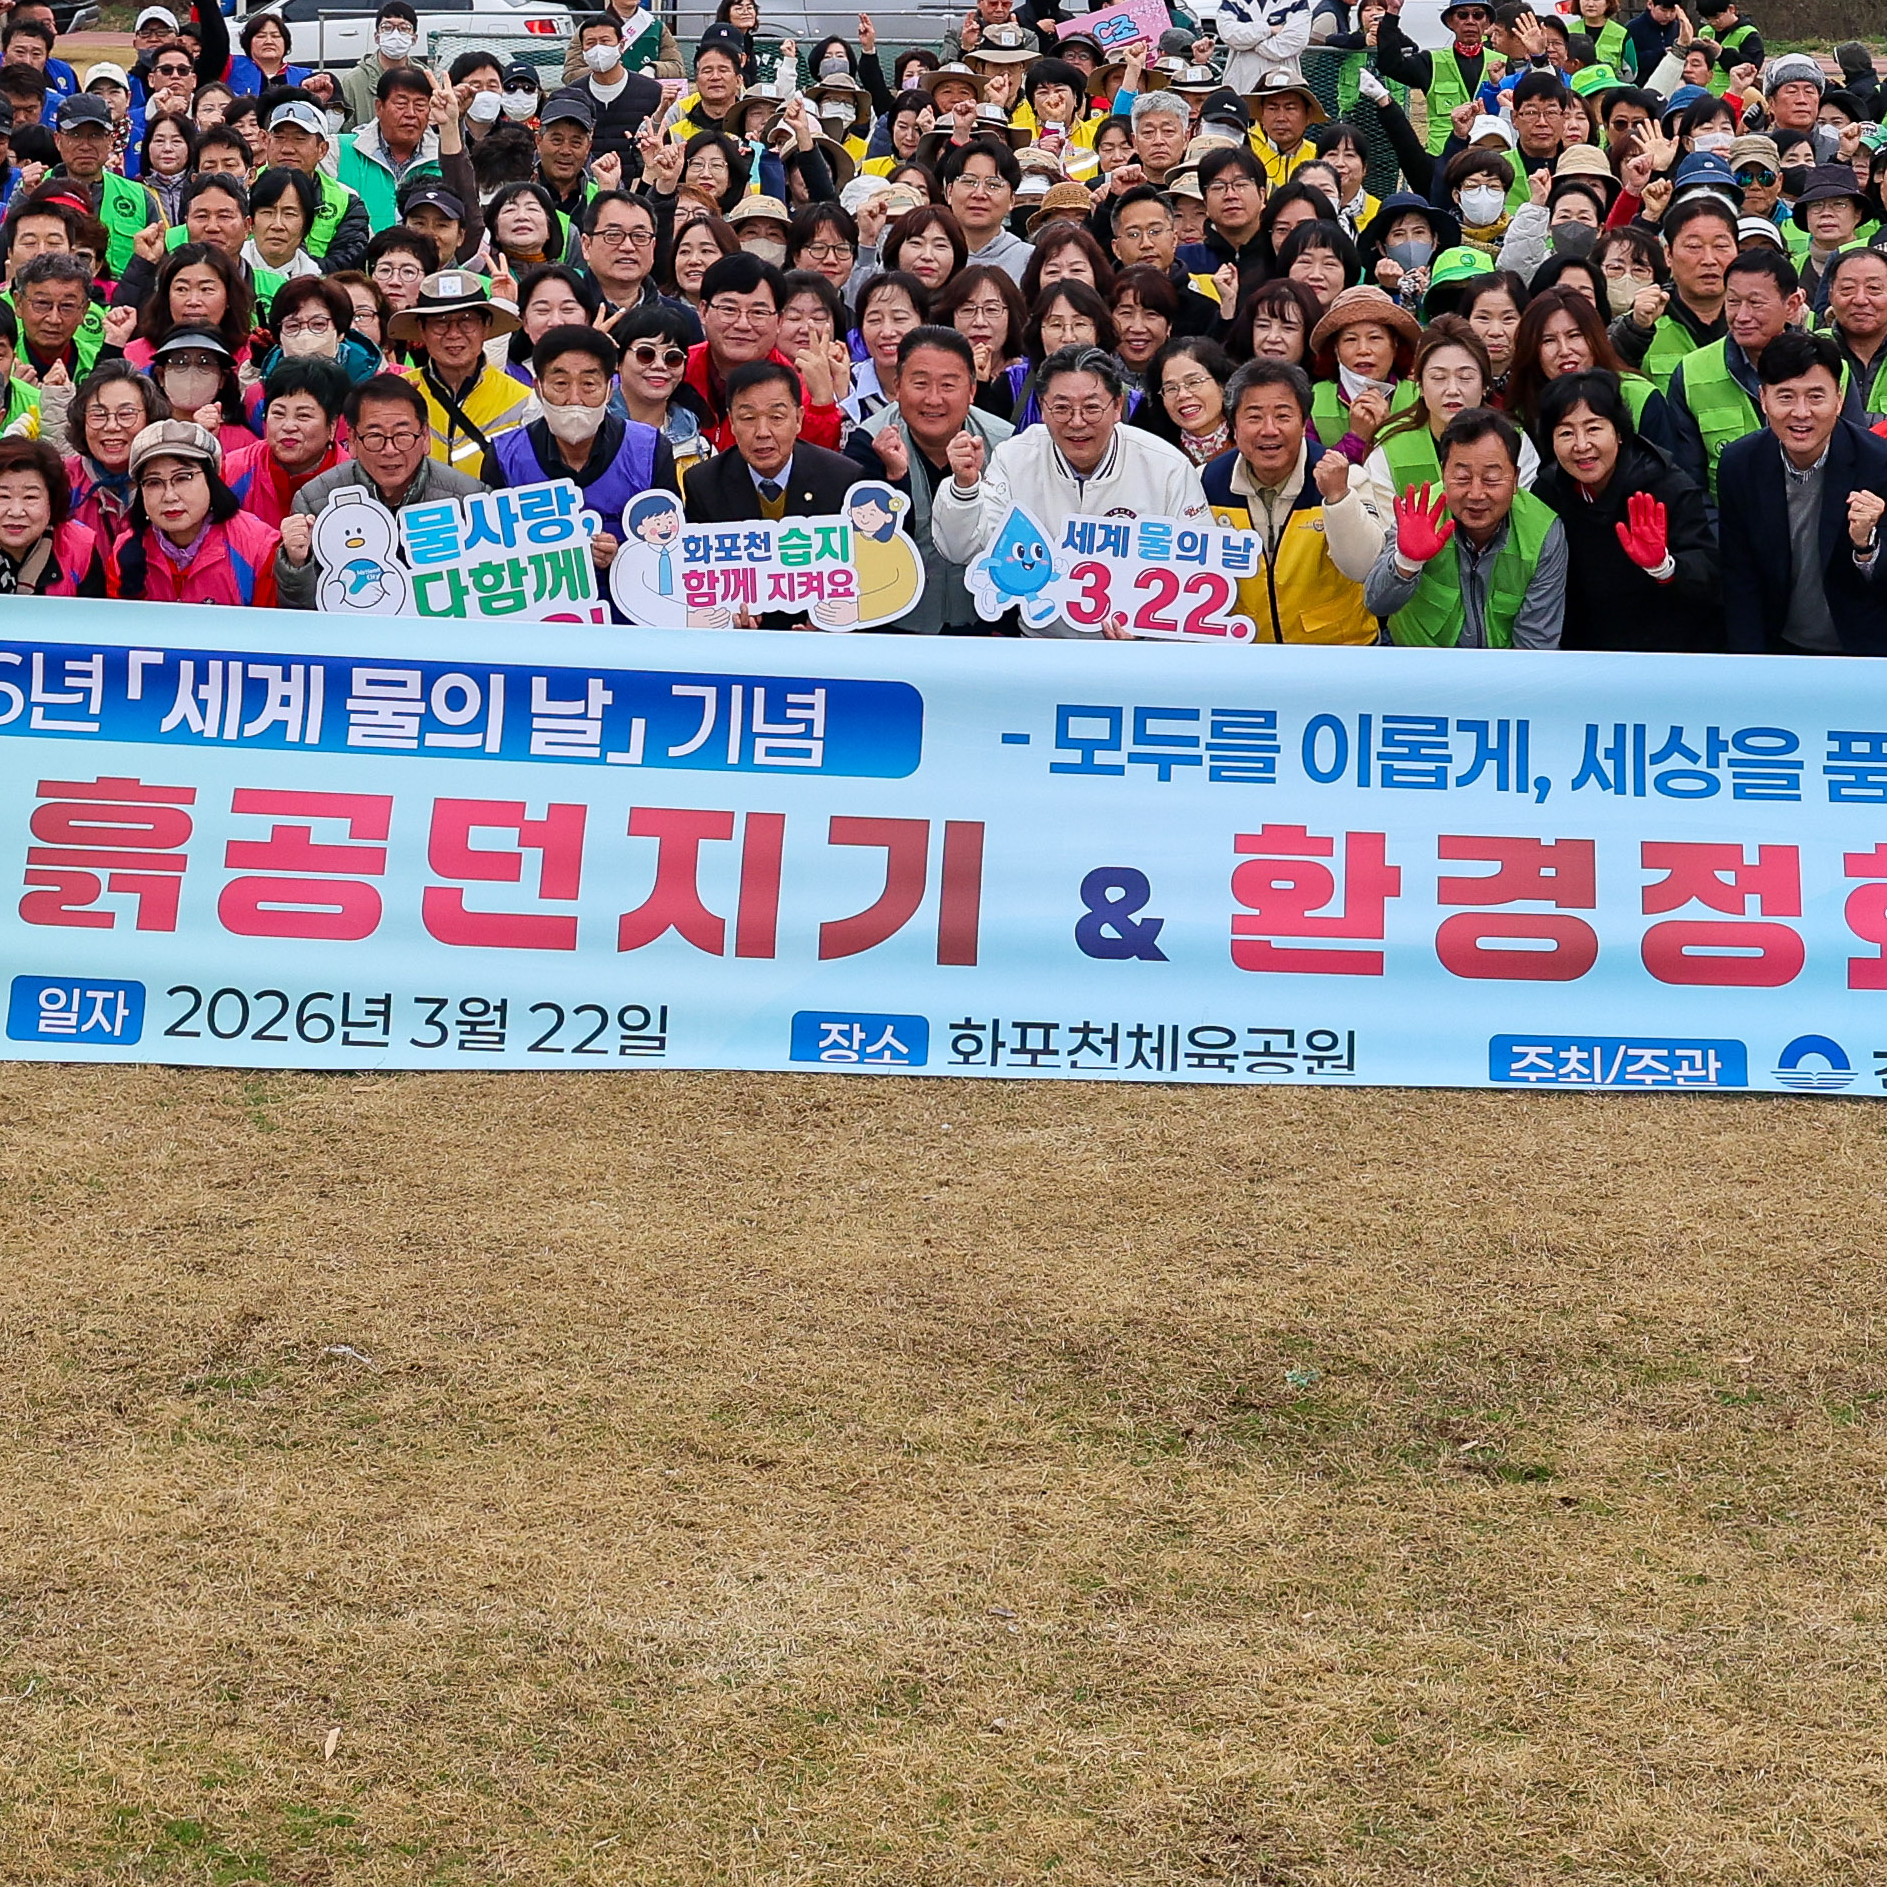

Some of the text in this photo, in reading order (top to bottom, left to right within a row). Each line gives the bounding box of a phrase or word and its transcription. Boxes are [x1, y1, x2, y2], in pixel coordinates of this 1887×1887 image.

[404, 486, 595, 565] 물사랑,
[681, 525, 849, 566] 화포천 습지
[1061, 520, 1255, 571] 세계 물의 날
[411, 547, 592, 618] 다함께
[681, 567, 855, 608] 함께 지켜요
[1065, 561, 1248, 639] 3.22.
[345, 666, 505, 753] 물의
[666, 682, 826, 769] 기념
[1049, 704, 1282, 786] 모두를
[1300, 711, 1552, 805] 이롭게,
[1570, 722, 1804, 802] 세상을
[1074, 866, 1170, 963] &
[37, 985, 670, 1058] 일자 2026년 3월 22일
[816, 1016, 1357, 1077] 장소 화포천체육공원
[1509, 1043, 1722, 1089] 주최/주관
